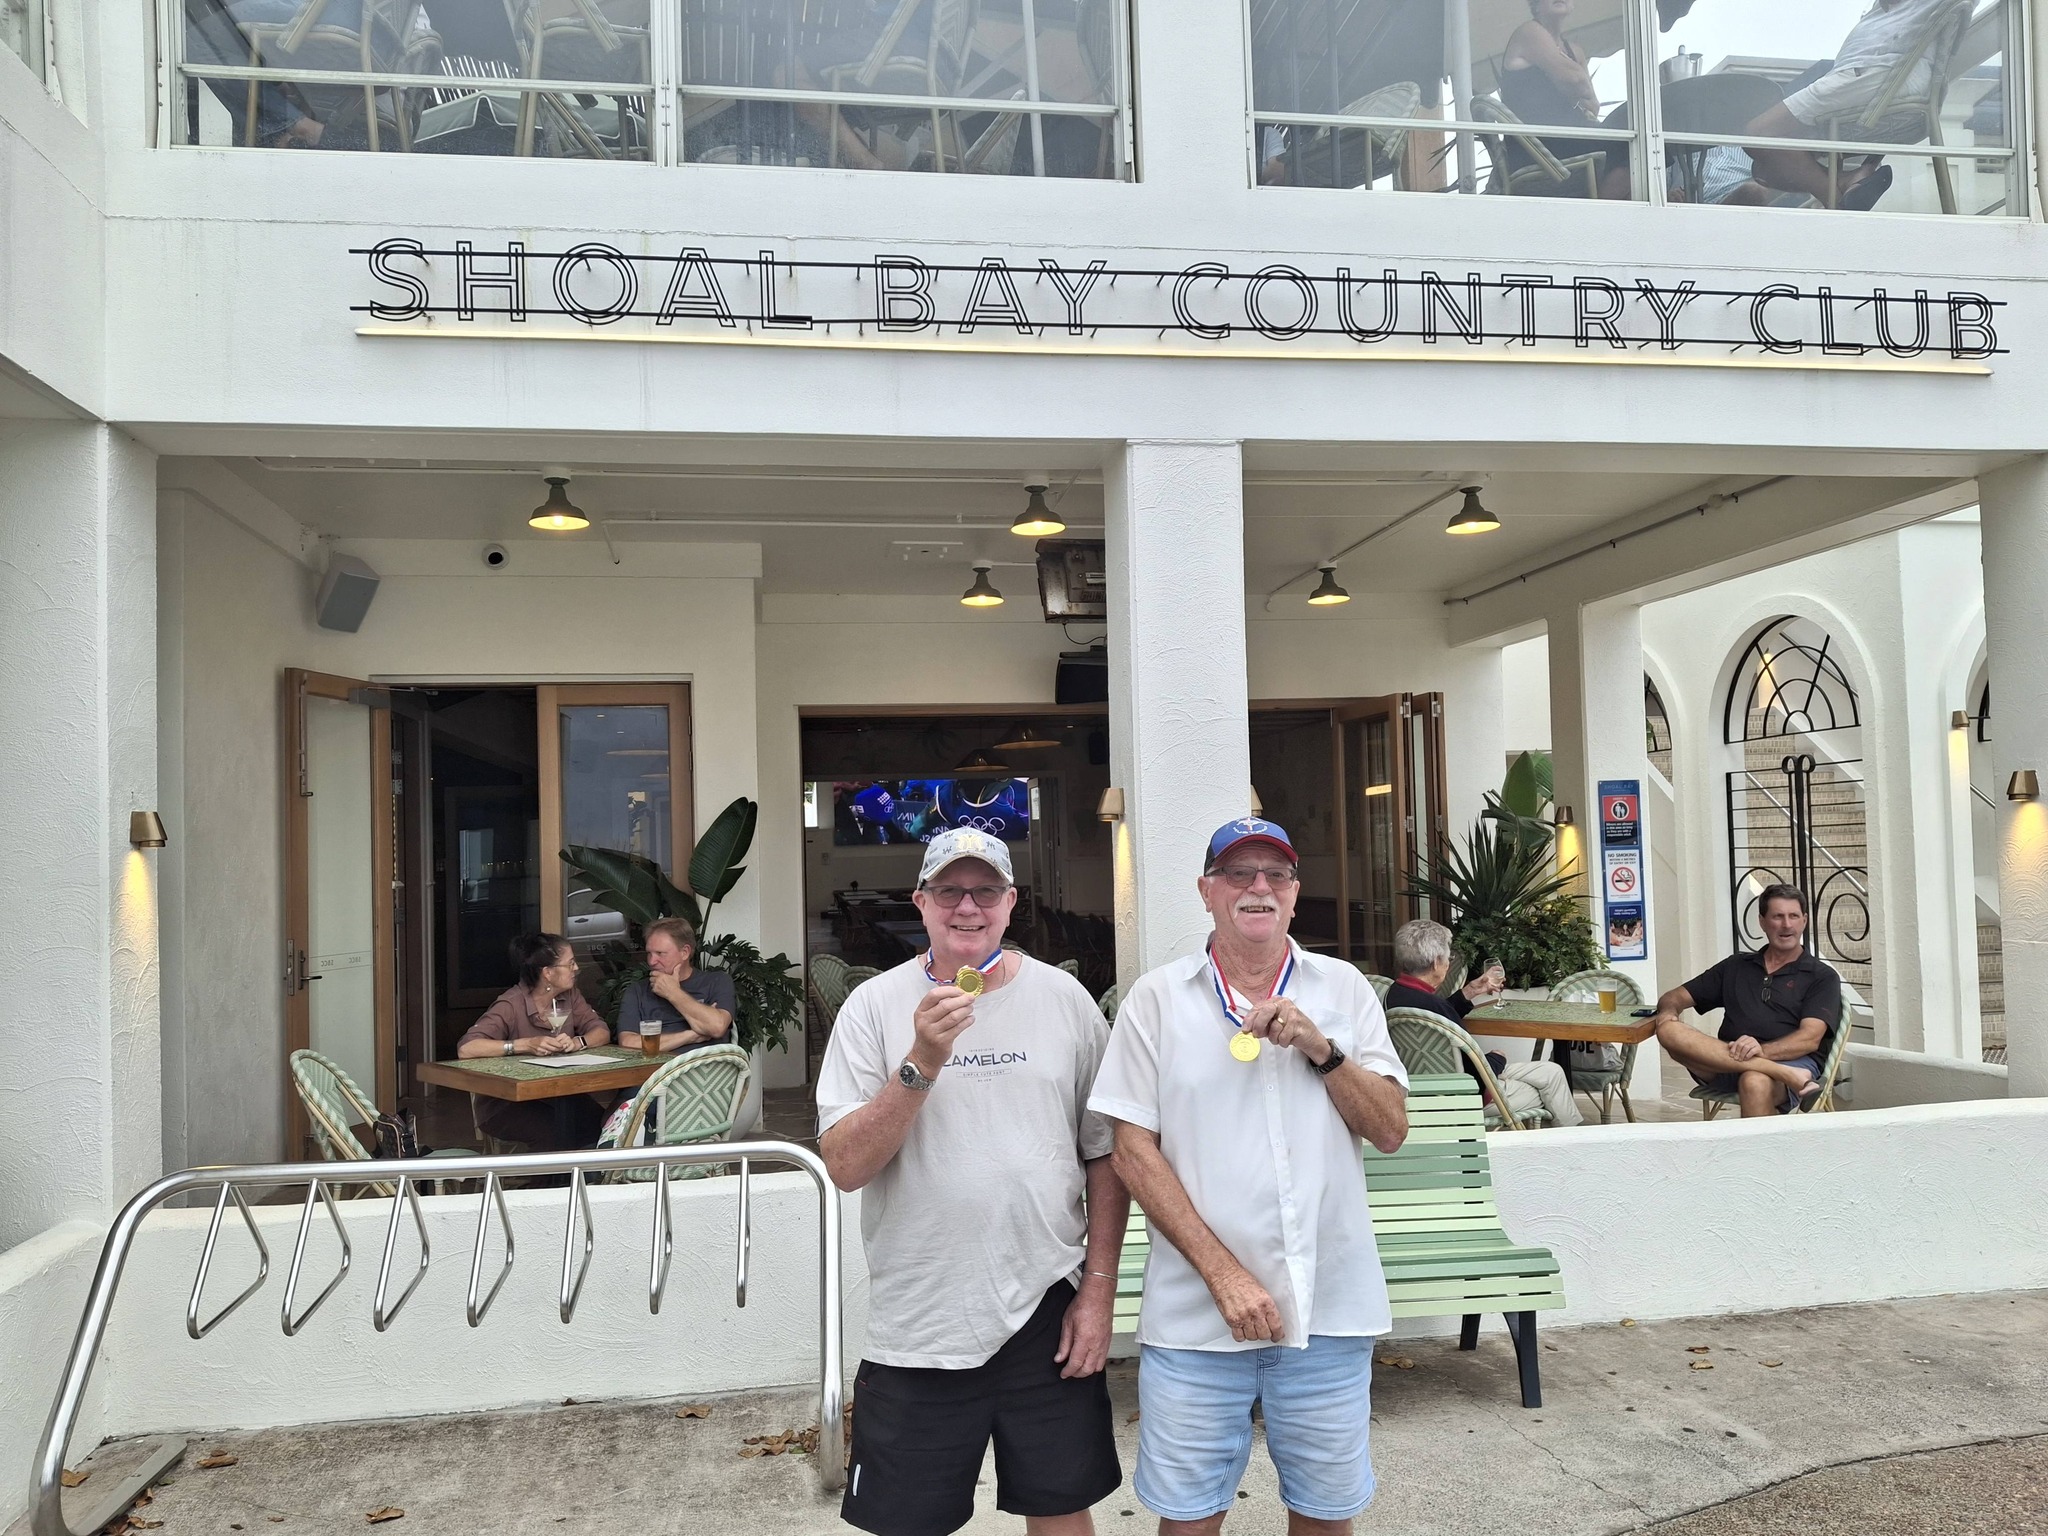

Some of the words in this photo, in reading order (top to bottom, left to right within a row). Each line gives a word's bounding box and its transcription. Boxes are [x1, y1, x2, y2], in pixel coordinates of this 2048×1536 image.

[369, 237, 813, 330] SHOAL
[874, 253, 1107, 336] BAY
[1172, 261, 1696, 351] COUNTRY
[1749, 283, 1998, 360] CLUB
